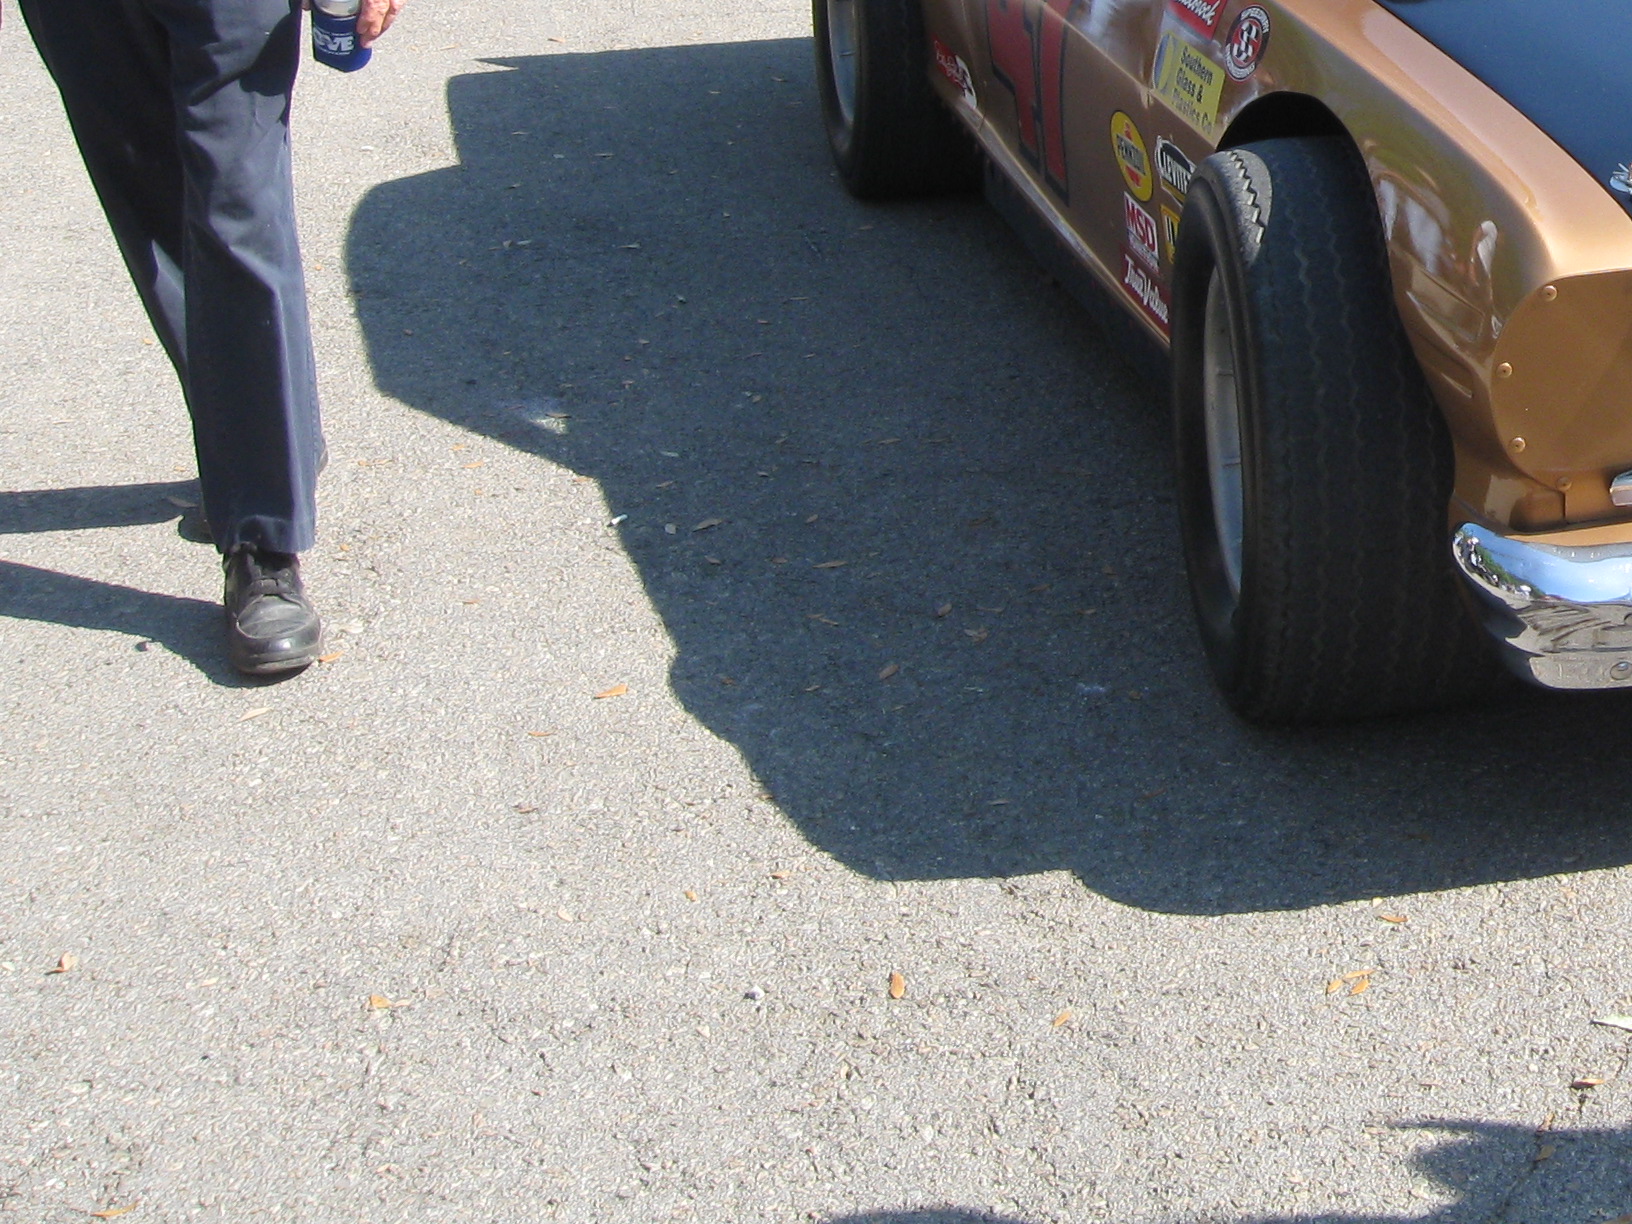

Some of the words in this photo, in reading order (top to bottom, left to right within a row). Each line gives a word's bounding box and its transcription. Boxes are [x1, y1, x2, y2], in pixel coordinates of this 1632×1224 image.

[1176, 67, 1197, 97] Glass
[1196, 84, 1204, 104] &
[1180, 45, 1213, 86] Southern
[1125, 196, 1157, 253] MSD
